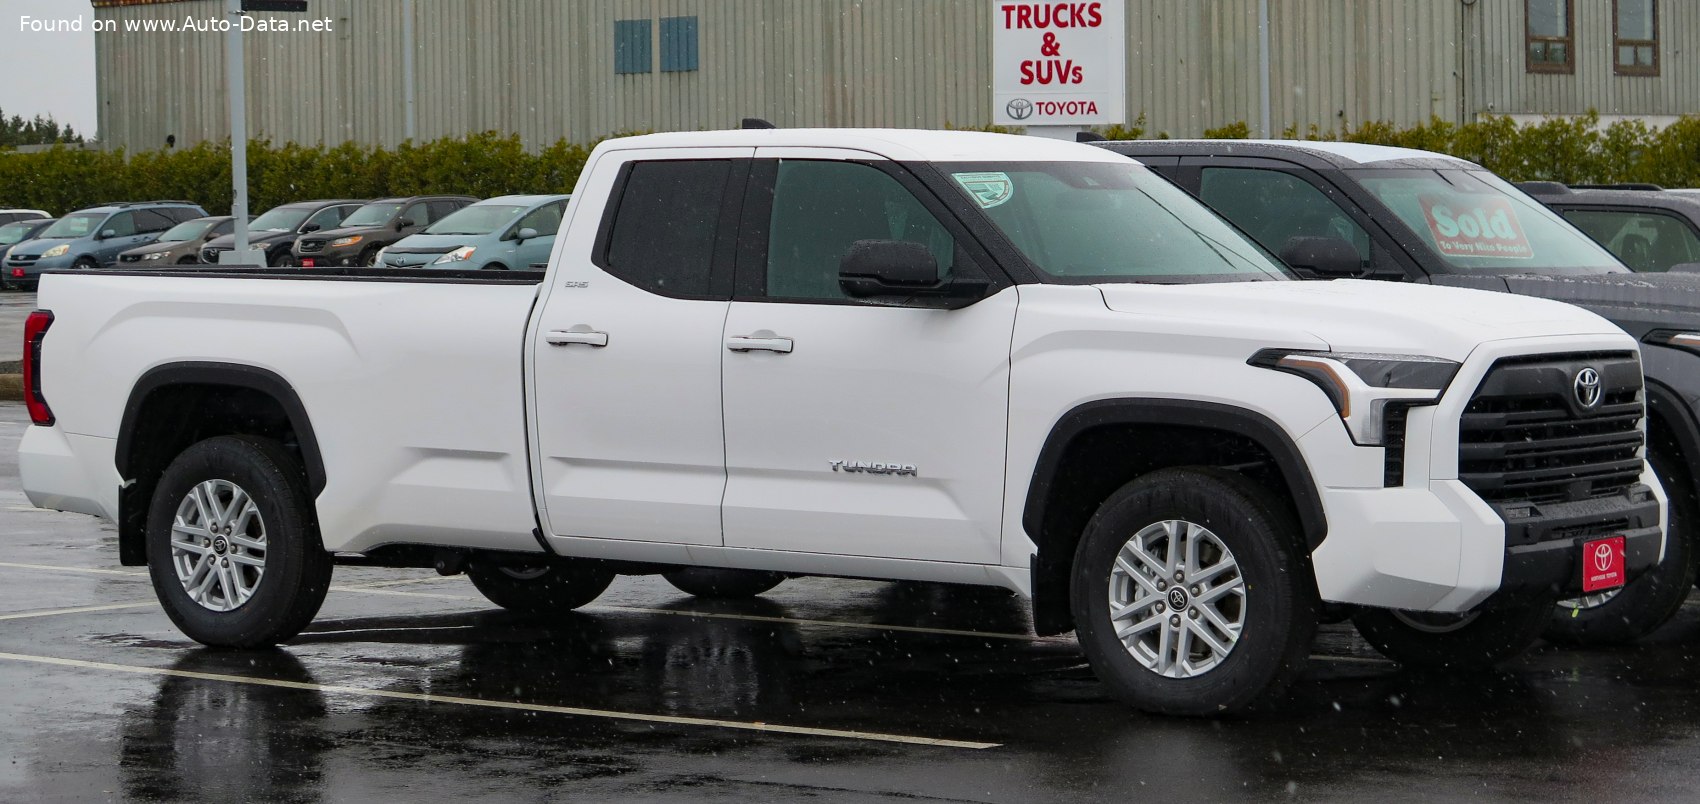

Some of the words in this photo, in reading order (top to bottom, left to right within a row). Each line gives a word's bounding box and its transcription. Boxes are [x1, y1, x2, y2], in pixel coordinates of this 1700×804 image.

[1001, 3, 1102, 29] TRUCKS
[1041, 32, 1060, 56] &
[1020, 60, 1083, 85] SUVs
[1035, 101, 1098, 115] TOYOTA
[1432, 204, 1517, 239] Sold
[1440, 241, 1452, 249] To
[1453, 241, 1474, 252] Very
[829, 460, 917, 476] TUNDRA
